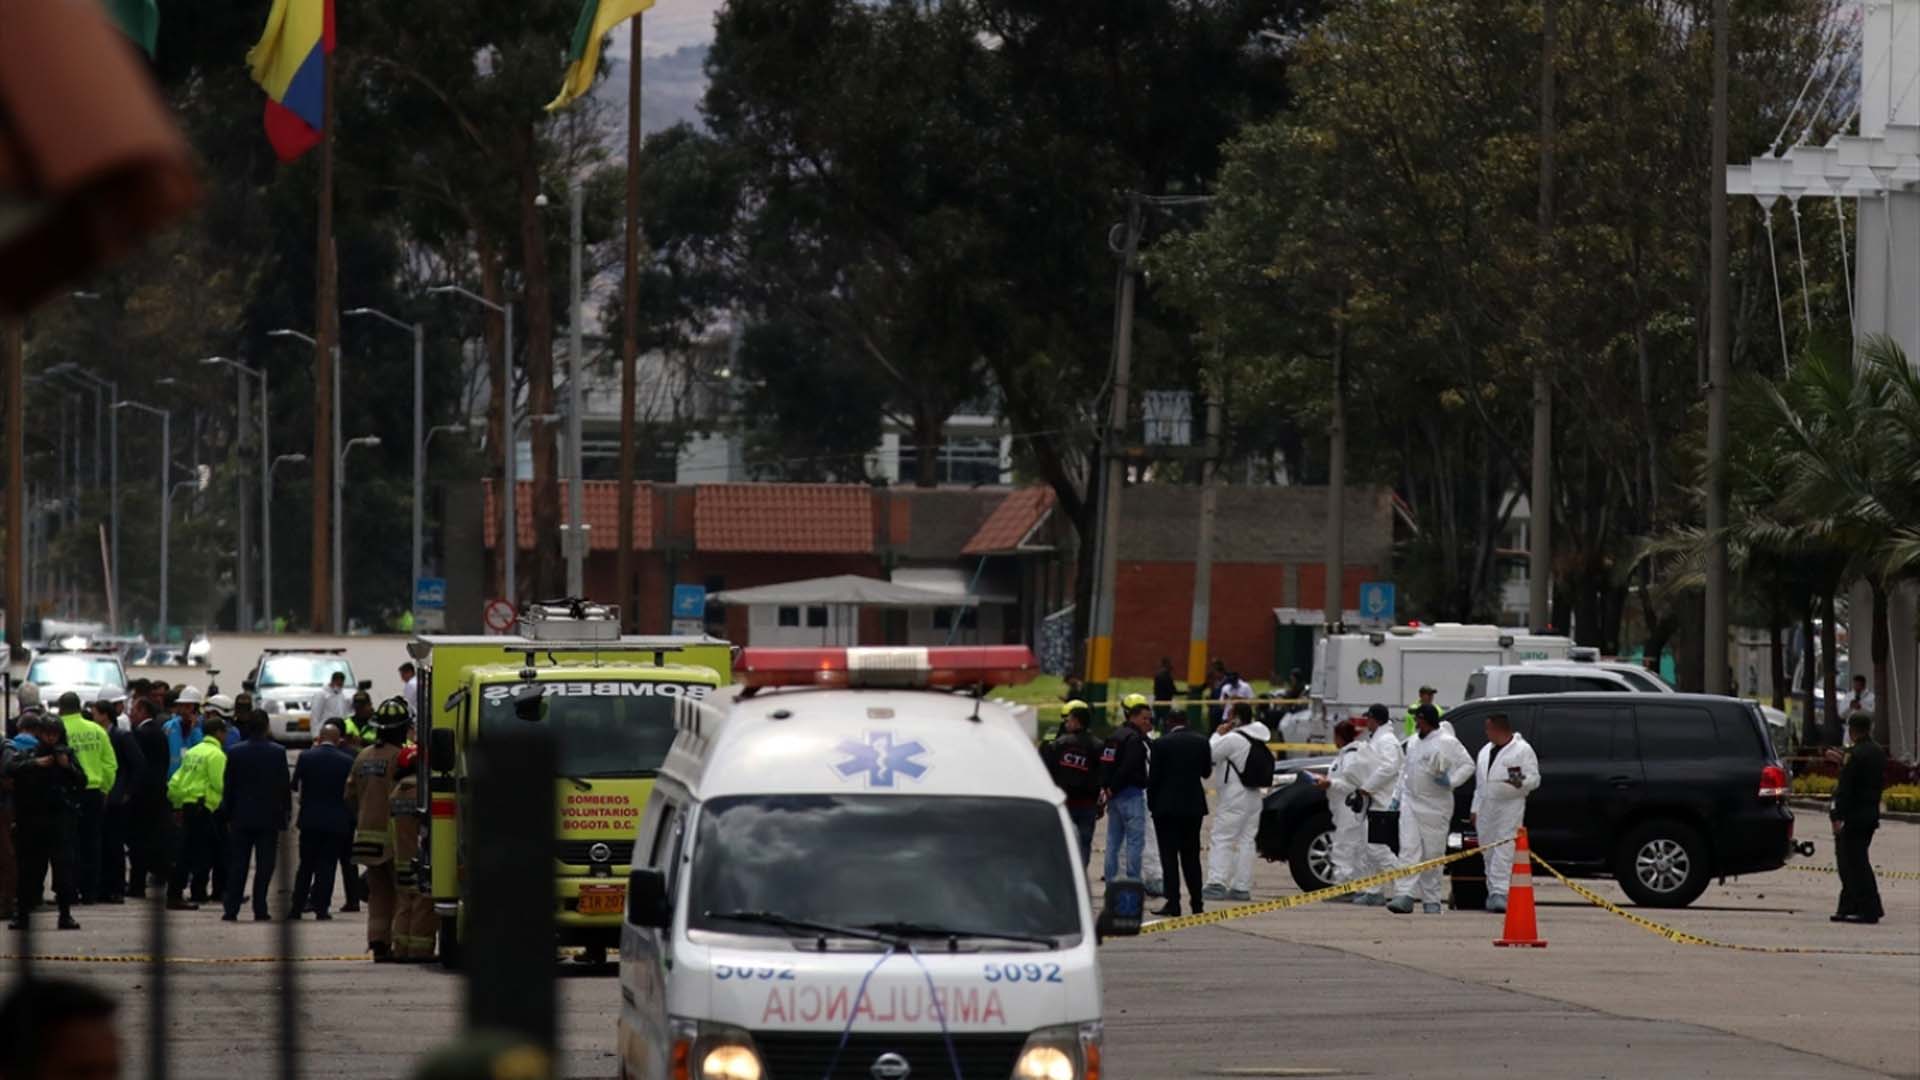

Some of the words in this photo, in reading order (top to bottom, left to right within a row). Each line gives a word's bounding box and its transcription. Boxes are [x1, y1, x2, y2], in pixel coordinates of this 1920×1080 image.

[1063, 752, 1087, 766] CTI
[567, 796, 630, 805] BOMBEROS
[560, 807, 639, 817] VOLUNTARIOS
[562, 820, 610, 830] BOGOTA
[613, 820, 635, 830] D.C.
[983, 962, 1064, 983] 5092
